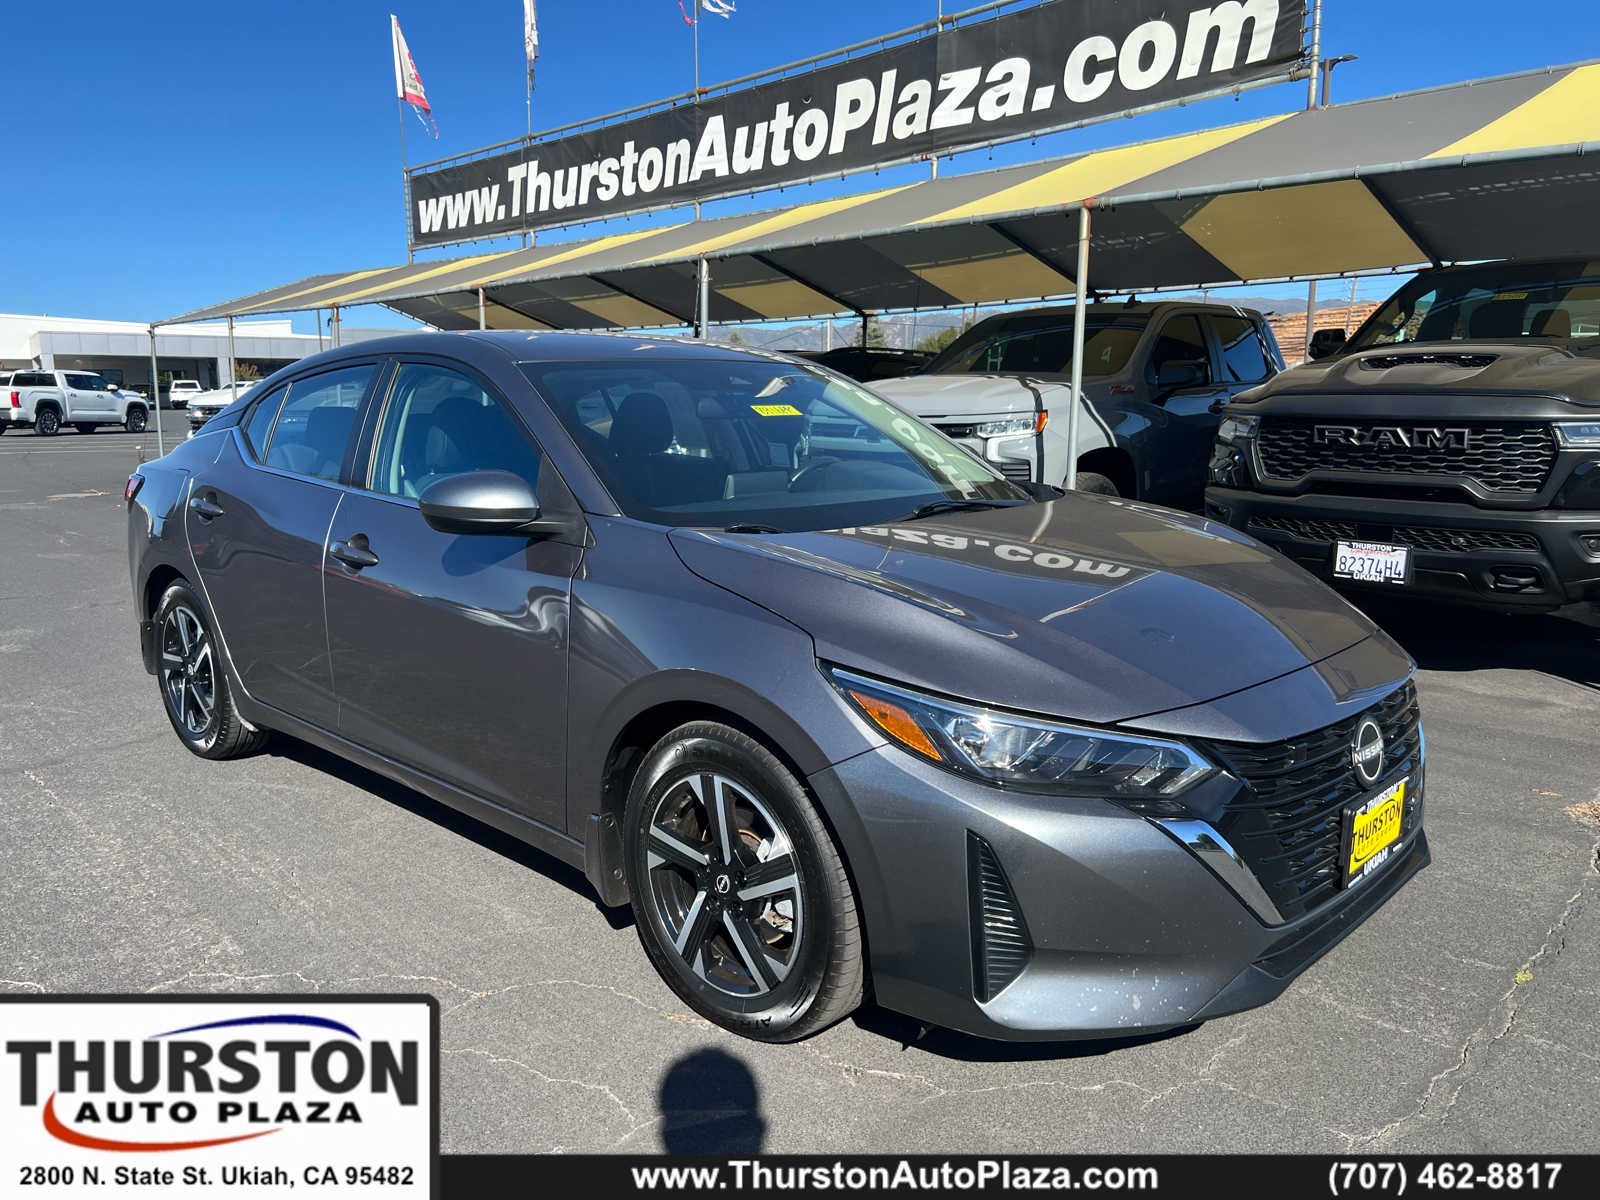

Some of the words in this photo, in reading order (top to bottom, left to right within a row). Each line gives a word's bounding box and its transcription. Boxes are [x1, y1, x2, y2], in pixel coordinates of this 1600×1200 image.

[418, 0, 1280, 234] www.ThurstonAutoPlaza.com
[1314, 425, 1470, 449] RAM
[1352, 542, 1392, 552] THURSTON
[1338, 555, 1402, 578] 82374H4
[1352, 797, 1401, 855] THURSTON
